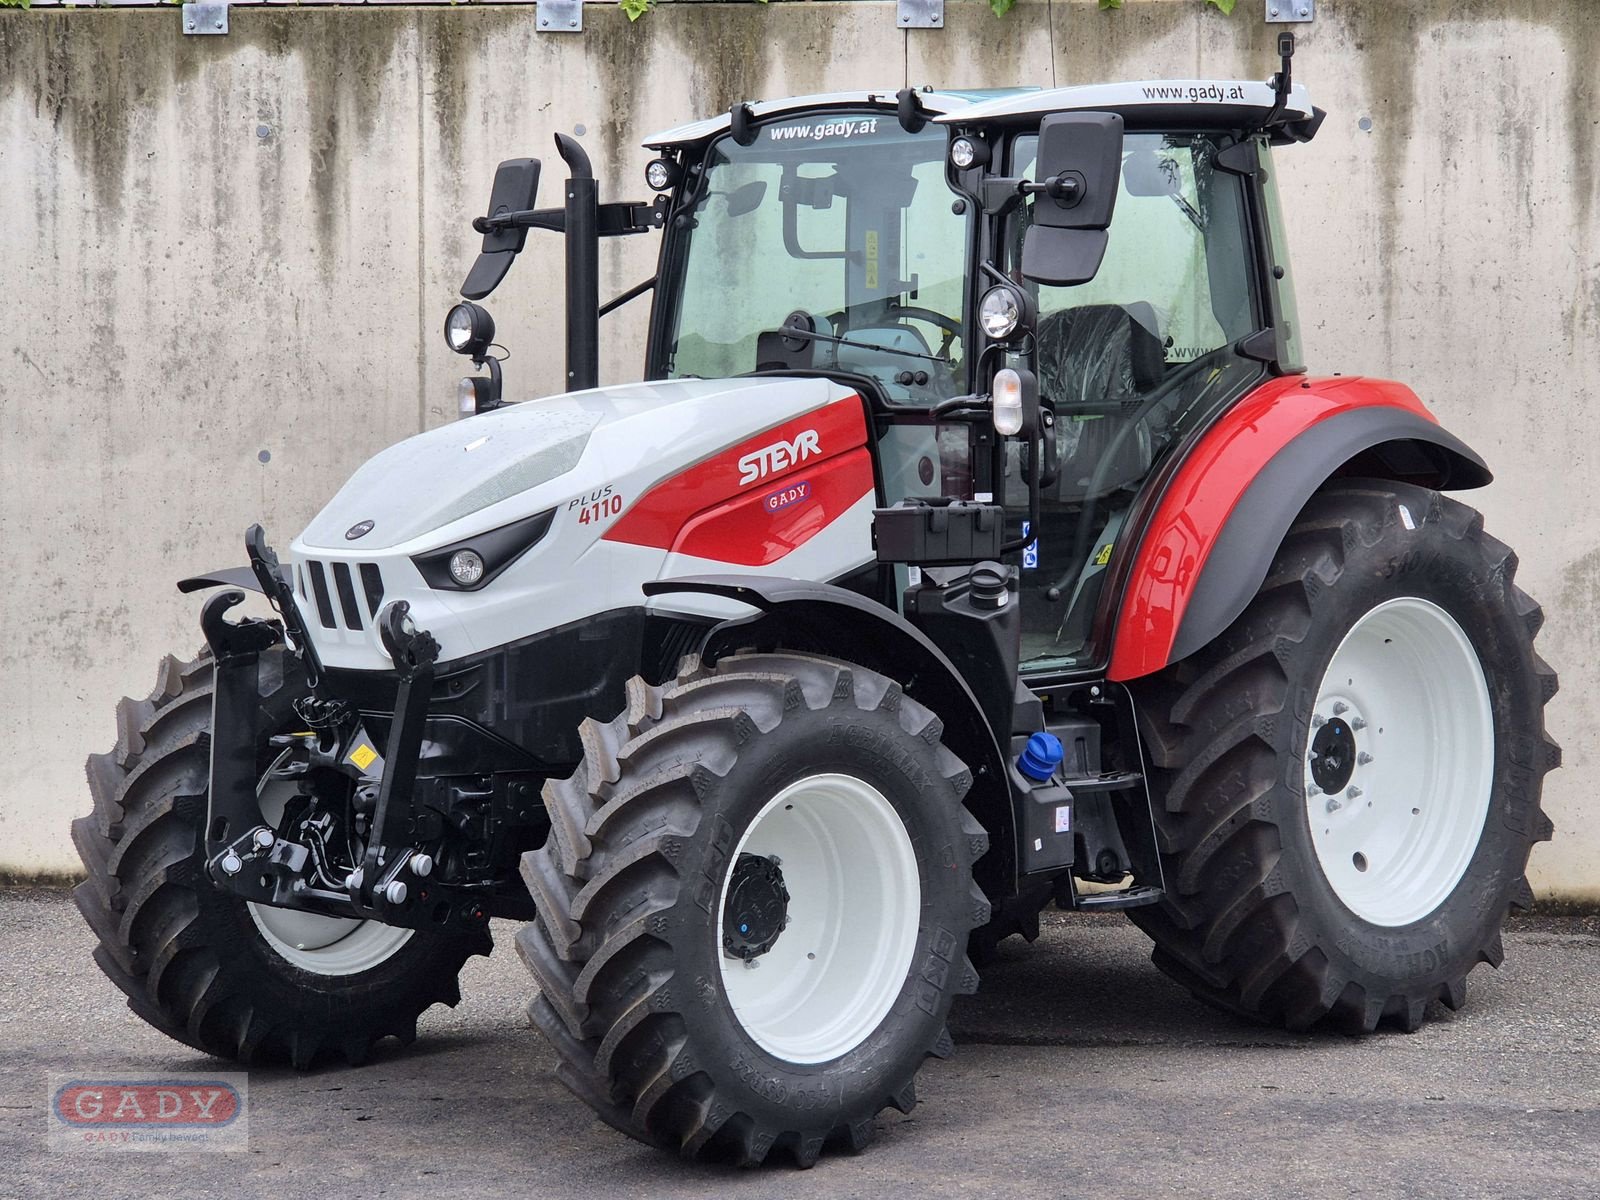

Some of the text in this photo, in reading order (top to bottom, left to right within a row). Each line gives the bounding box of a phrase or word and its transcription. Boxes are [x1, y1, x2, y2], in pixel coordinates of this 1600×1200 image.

[1142, 84, 1244, 103] www.gady.at
[770, 118, 878, 141] www.gady.at
[738, 429, 822, 486] STEYR
[568, 484, 613, 511] PLUS
[769, 484, 806, 508] GADY
[578, 494, 622, 525] 4110
